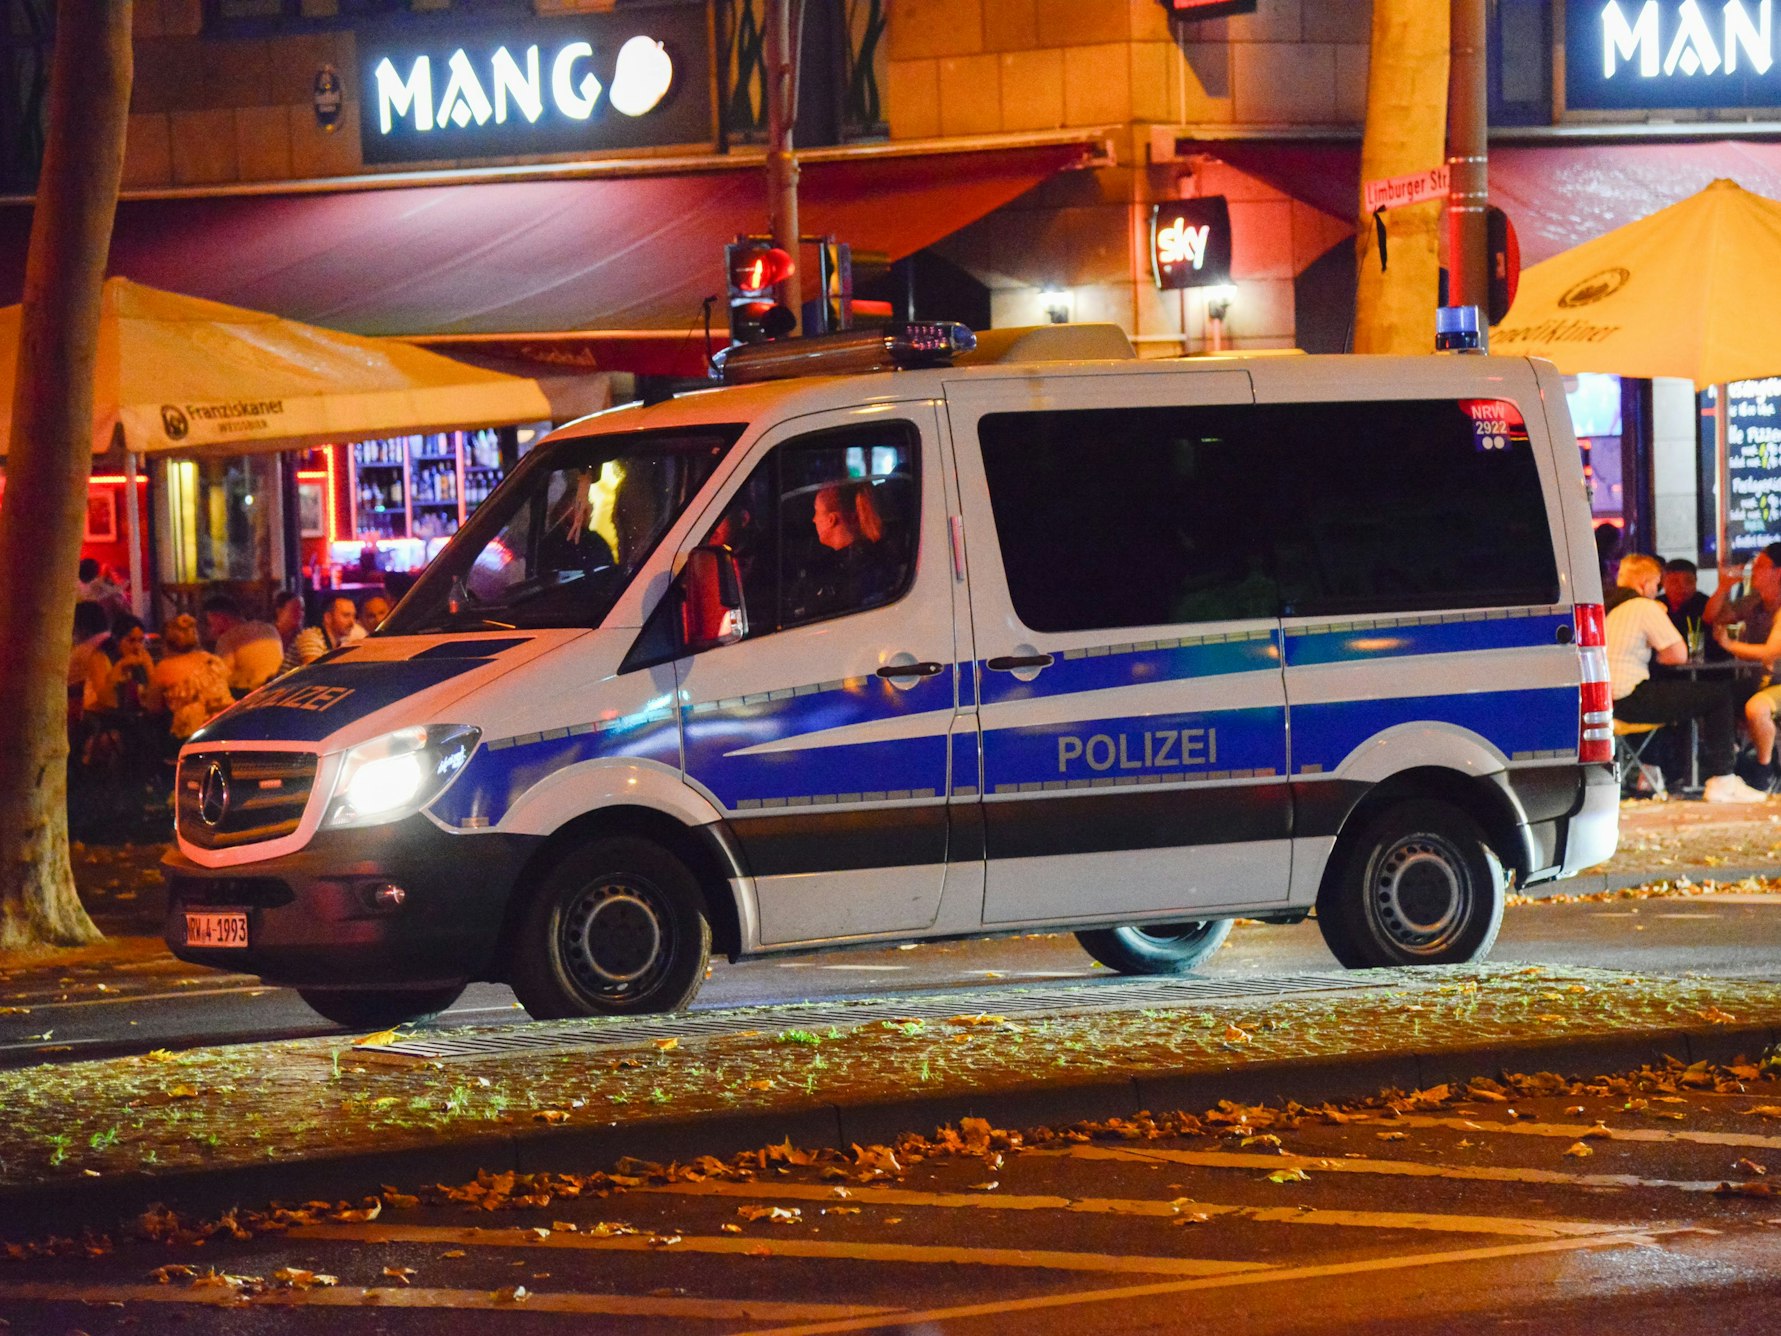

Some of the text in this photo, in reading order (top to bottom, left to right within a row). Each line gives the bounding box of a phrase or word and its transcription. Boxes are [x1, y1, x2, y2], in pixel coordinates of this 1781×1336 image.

[1601, 0, 1773, 79] MAN
[1367, 178, 1425, 204] Limburger
[1157, 217, 1210, 270] sky
[186, 400, 284, 420] Franziskaner
[1471, 405, 1505, 419] NRW
[1475, 420, 1507, 435] 2922
[1058, 728, 1217, 773] POLIZEI
